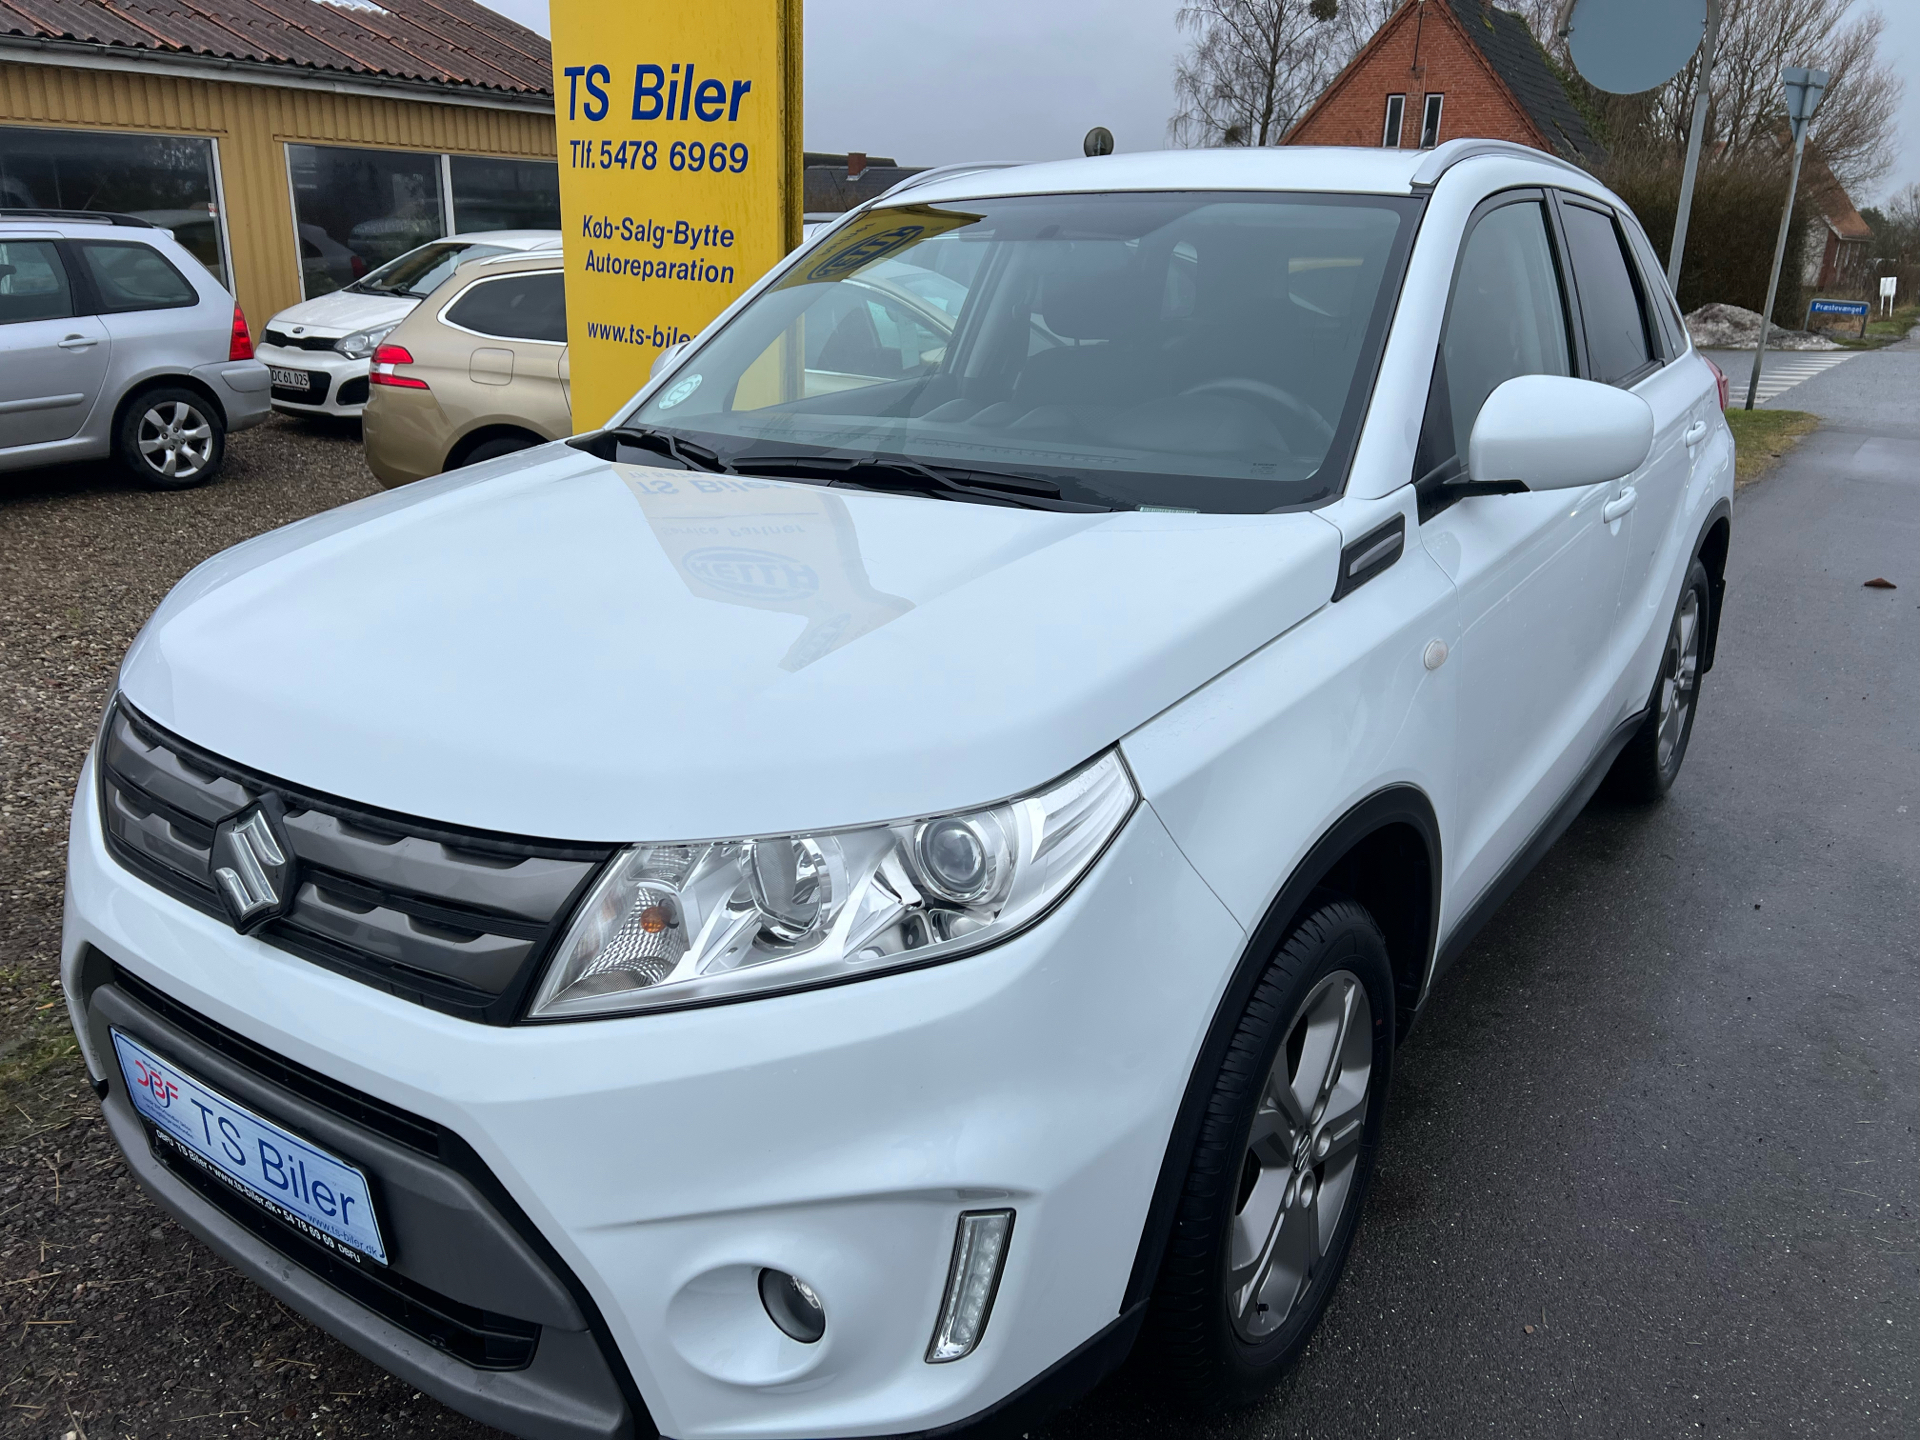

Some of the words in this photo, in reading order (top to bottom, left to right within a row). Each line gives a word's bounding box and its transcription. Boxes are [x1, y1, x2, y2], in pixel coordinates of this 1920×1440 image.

[564, 64, 611, 121] TS
[631, 63, 752, 122] Biler
[600, 140, 658, 171] 5478
[669, 140, 749, 174] 6969
[582, 214, 735, 250] Køb-Salg-Bytte
[585, 249, 735, 284] Autoreparation
[1815, 303, 1863, 315] Præstevænget
[587, 321, 698, 349] www.ts-bile
[284, 371, 293, 385] 61
[295, 373, 308, 386] 025
[175, 1141, 189, 1157] TS
[190, 1097, 246, 1167] TS
[257, 1137, 355, 1226] Biler
[306, 1212, 379, 1259] www.ts-biler.dk
